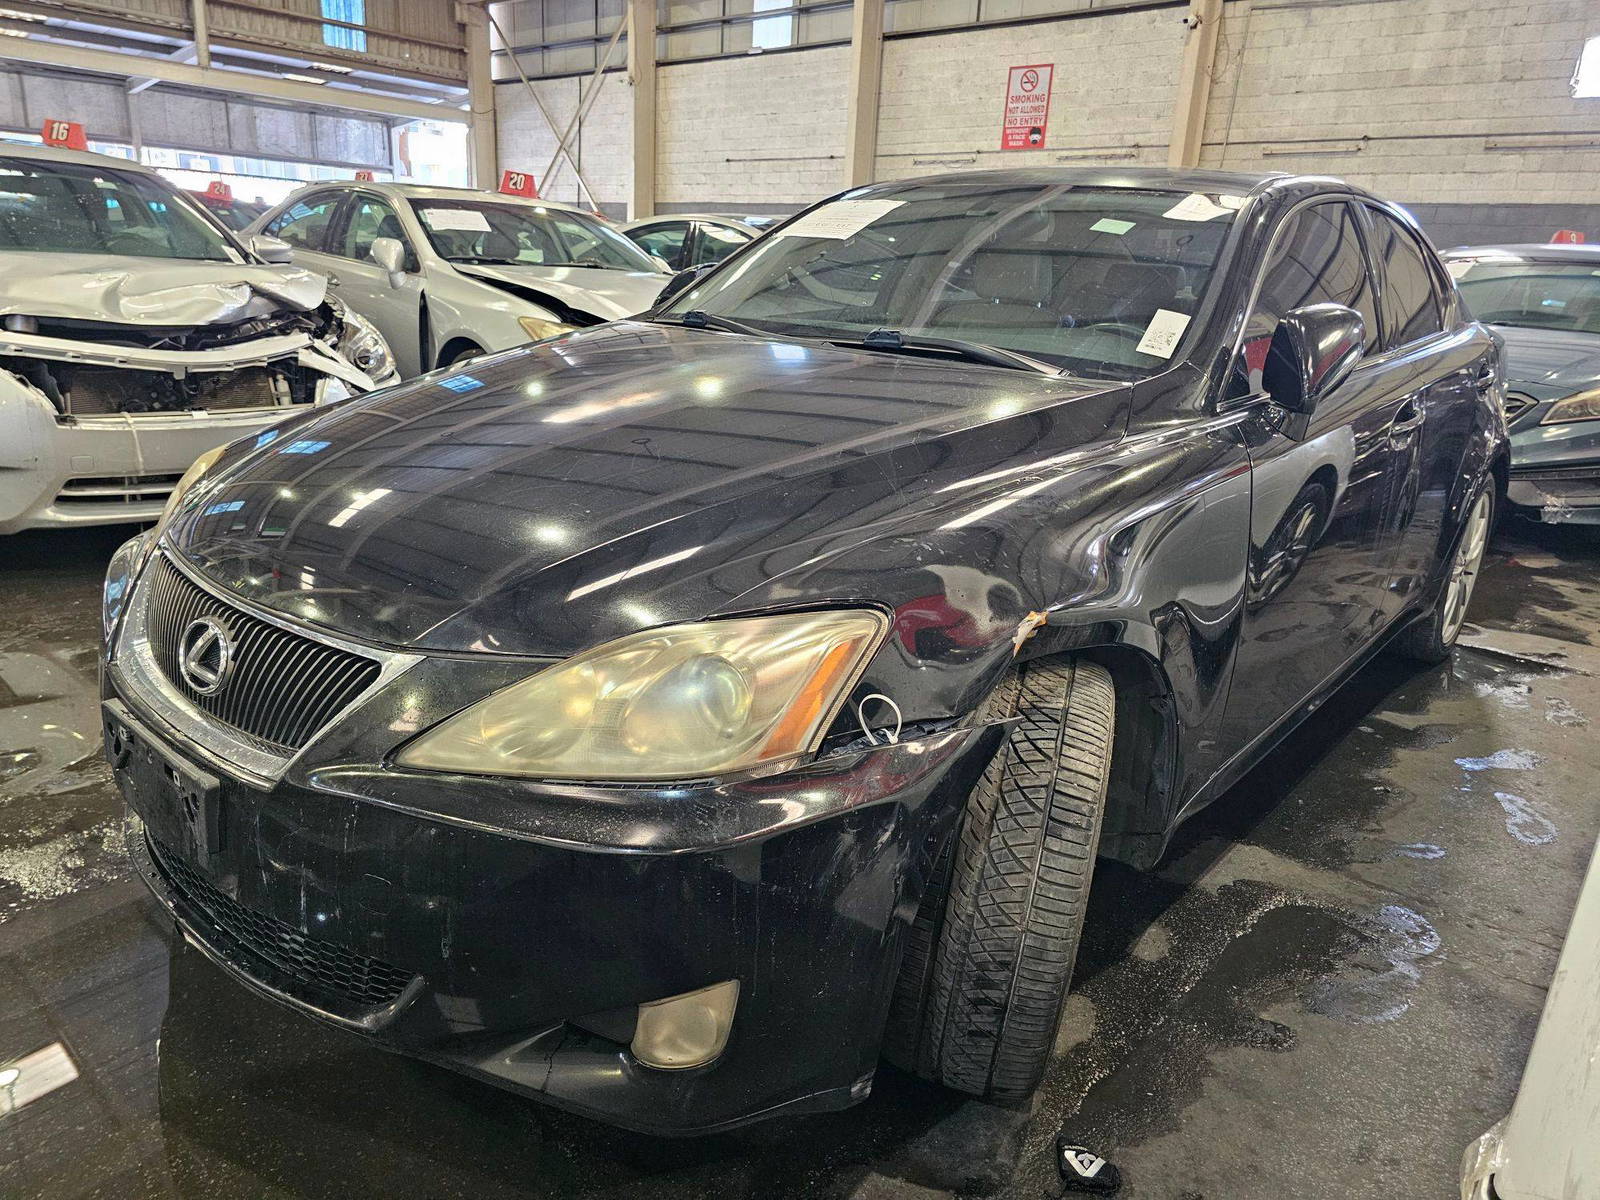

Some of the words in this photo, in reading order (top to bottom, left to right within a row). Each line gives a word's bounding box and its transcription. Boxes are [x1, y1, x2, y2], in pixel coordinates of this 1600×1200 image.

[1010, 93, 1046, 104] SMOKING
[1008, 106, 1019, 115] NOT
[1020, 104, 1045, 114] ALLOWED
[1007, 118, 1018, 126] NO
[1019, 116, 1043, 126] ENTRY
[51, 122, 69, 141] 16
[509, 172, 525, 190] 20
[214, 183, 225, 195] 24
